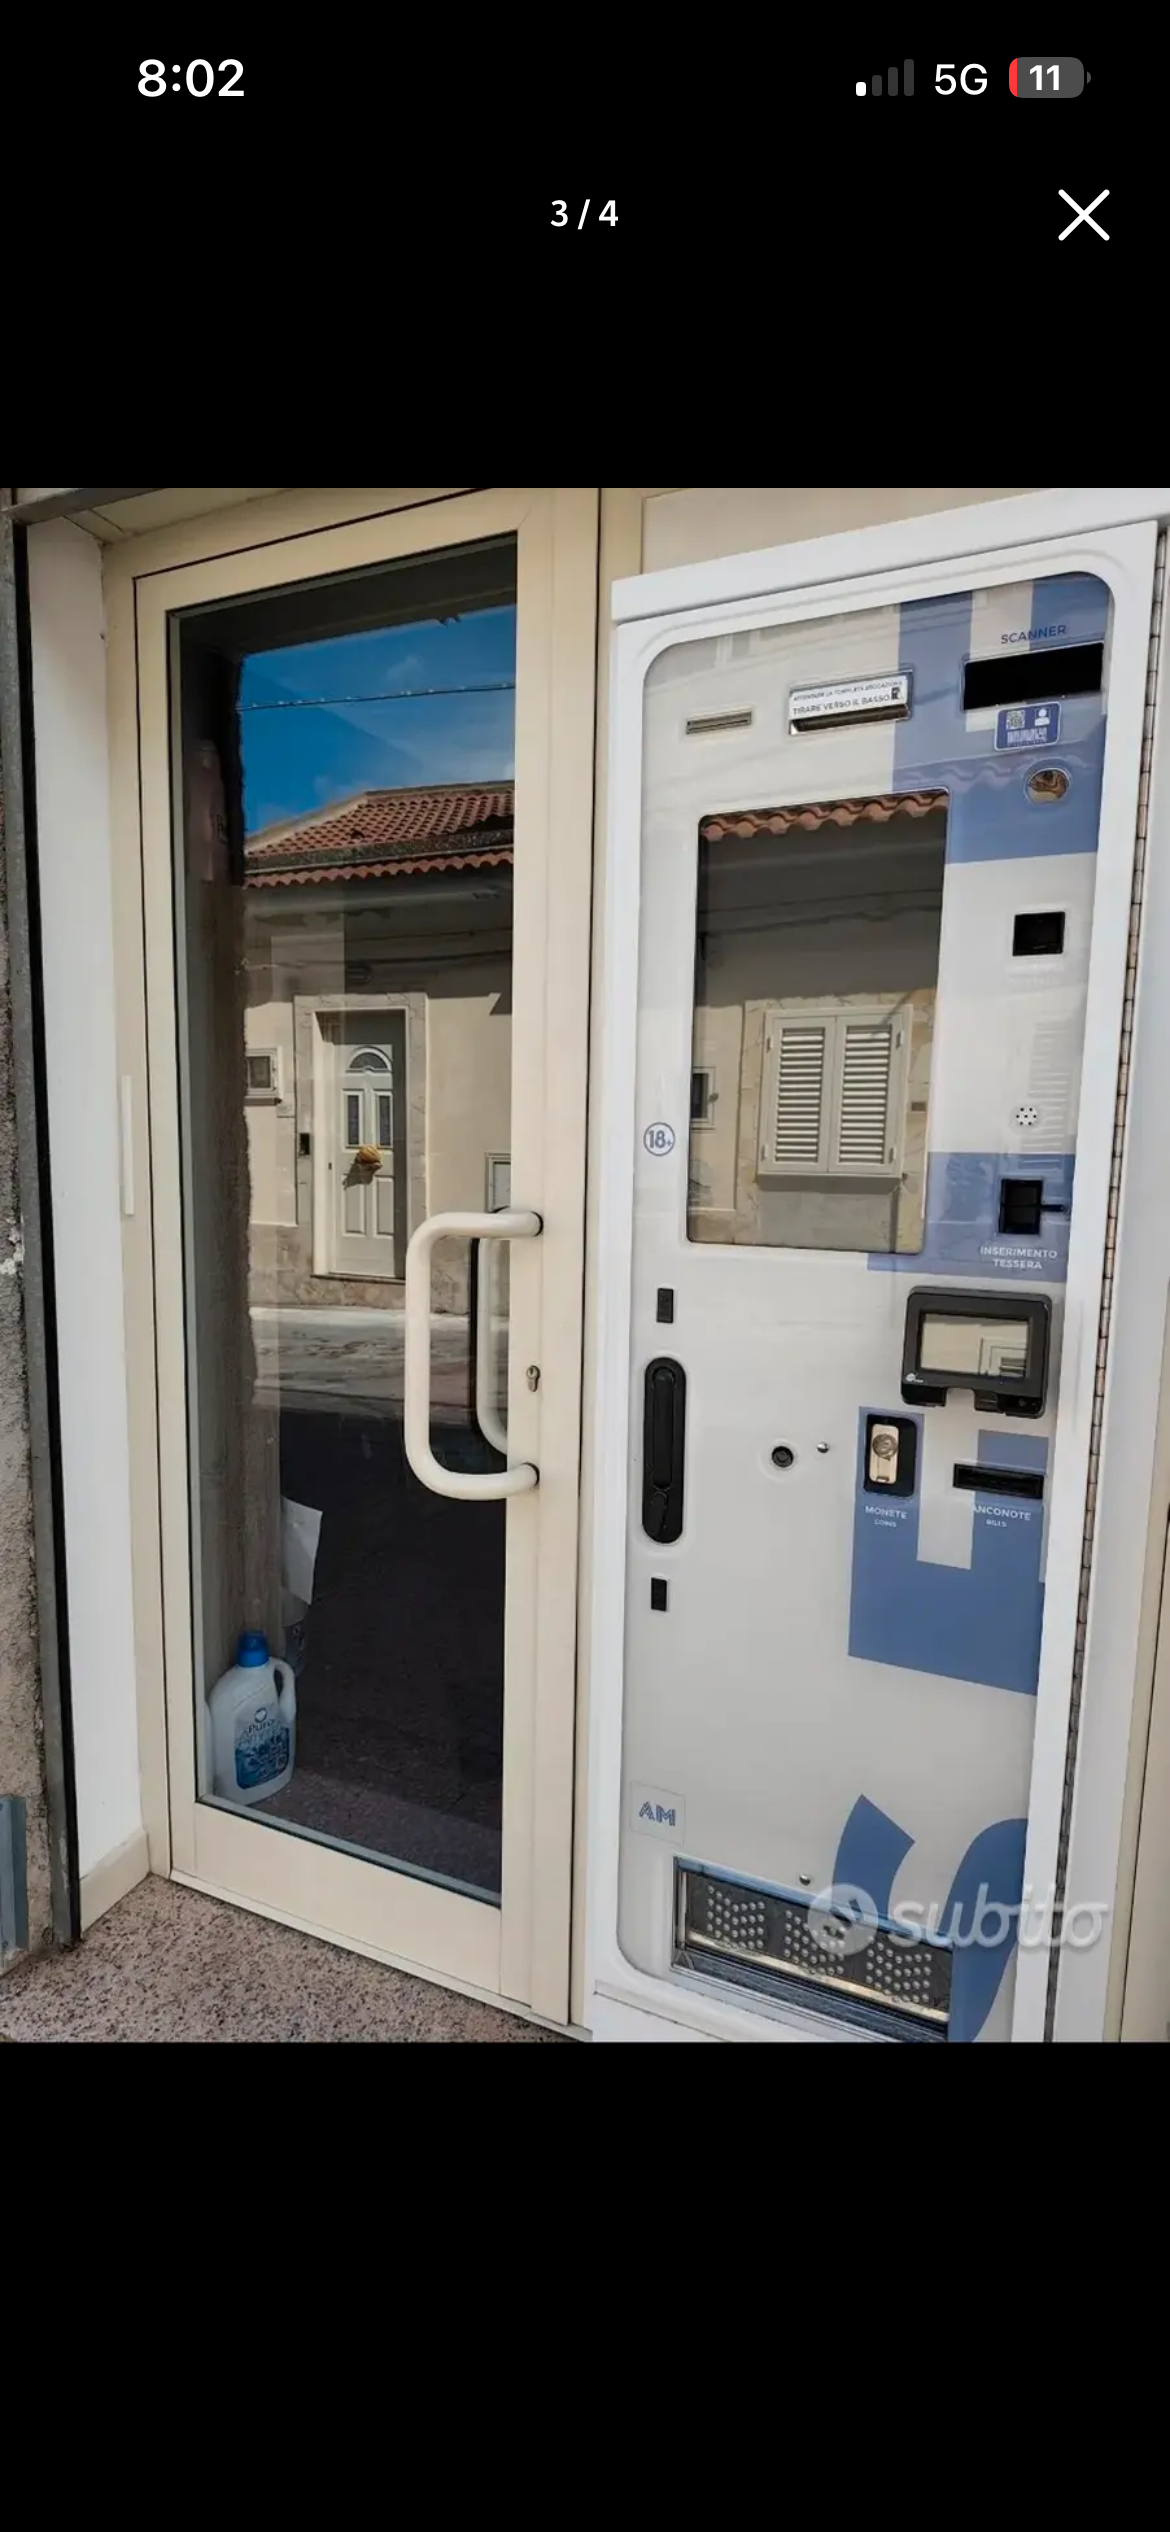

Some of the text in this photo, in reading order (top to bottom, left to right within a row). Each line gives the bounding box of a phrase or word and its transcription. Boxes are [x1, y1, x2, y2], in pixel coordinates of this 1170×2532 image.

[1000, 624, 1067, 644] SCANNER
[792, 704, 821, 715] TIRARE
[823, 700, 852, 710] VERSO
[862, 694, 890, 704] BASSO
[648, 1129, 673, 1149] 18+
[980, 1245, 1058, 1259] INSERIMENTO
[993, 1259, 1043, 1270] TESSERA
[864, 1505, 908, 1520] MONETE
